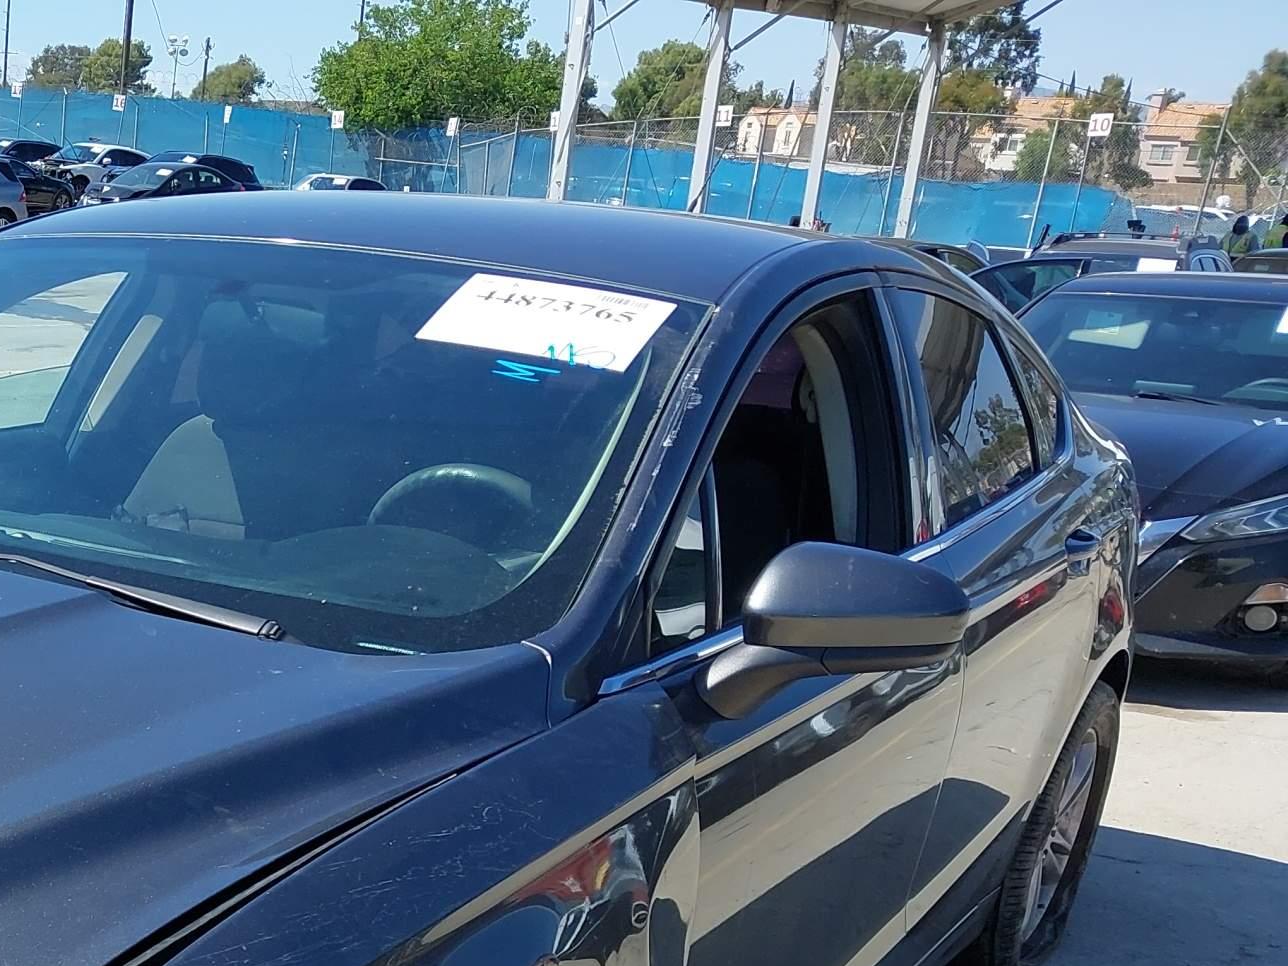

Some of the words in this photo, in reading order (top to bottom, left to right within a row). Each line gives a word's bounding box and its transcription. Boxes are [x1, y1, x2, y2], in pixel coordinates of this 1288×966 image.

[716, 109, 731, 123] 11
[1090, 118, 1111, 132] 10
[477, 290, 638, 323] 44873765
